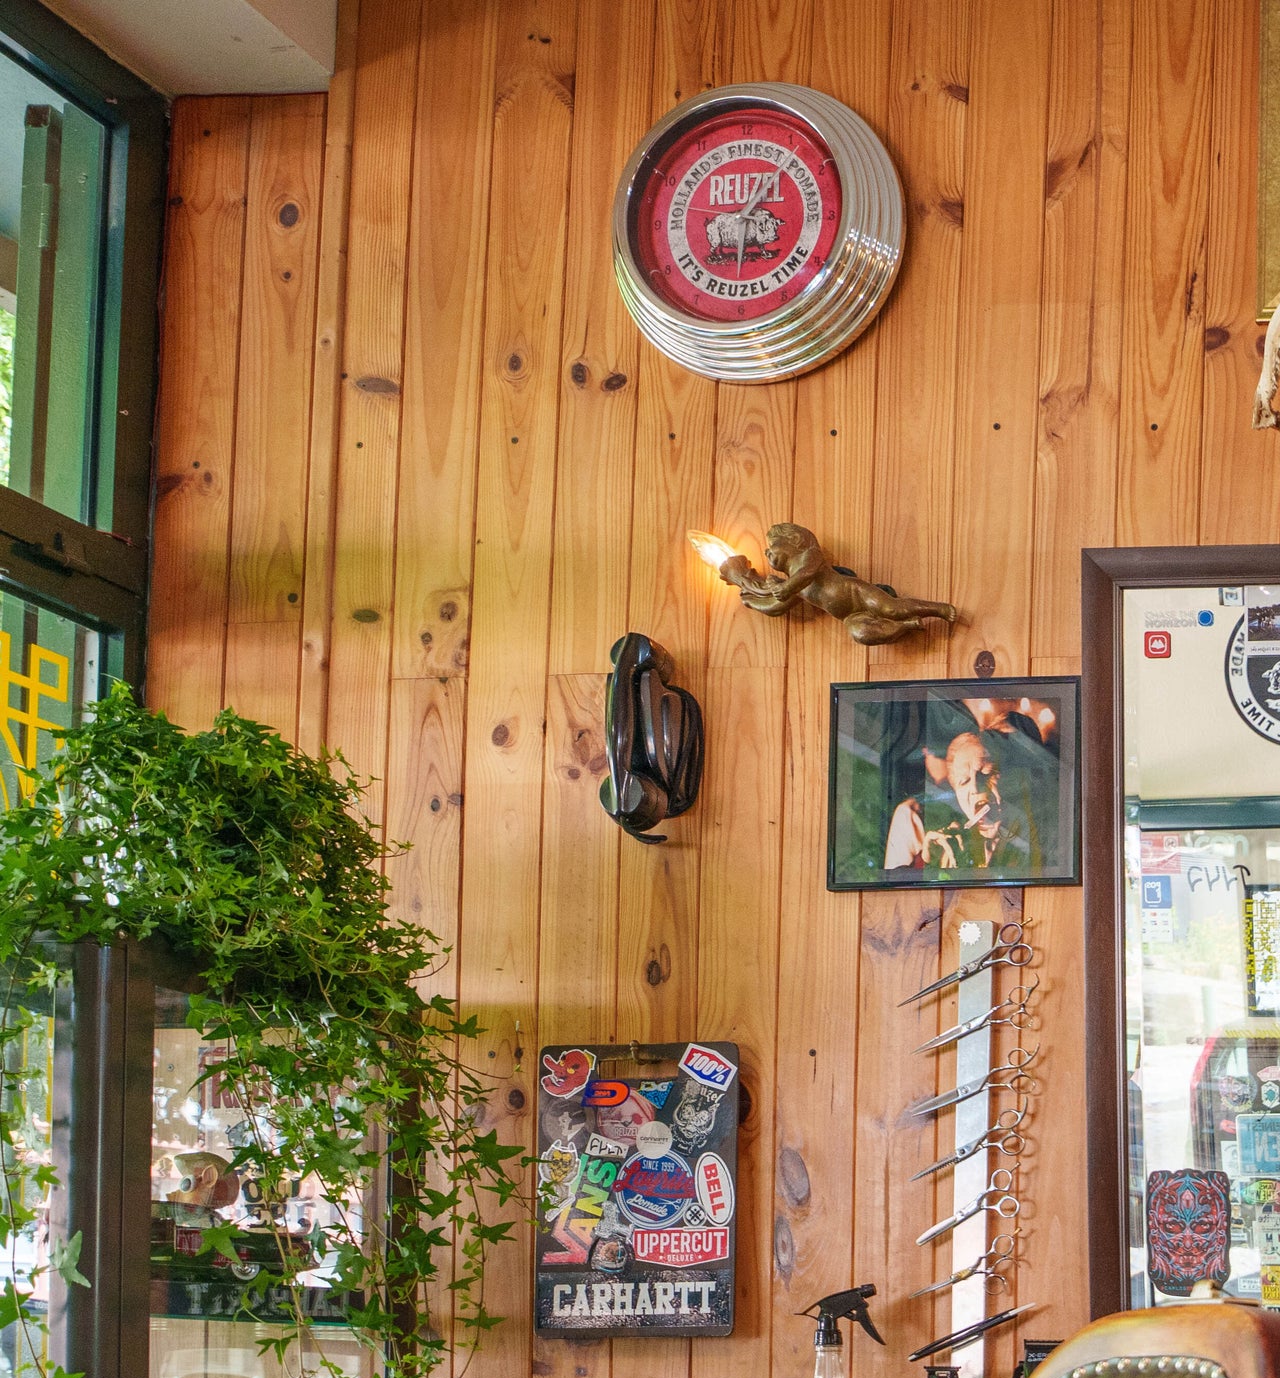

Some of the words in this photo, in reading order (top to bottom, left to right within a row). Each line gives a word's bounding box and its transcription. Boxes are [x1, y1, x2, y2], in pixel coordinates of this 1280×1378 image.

[741, 125, 753, 136] 12
[788, 134, 793, 145] 1
[696, 141, 707, 151] 11
[818, 164, 825, 176] 2
[664, 176, 676, 187] 10
[670, 152, 723, 231] HOLLAND'S
[727, 143, 785, 163] FINEST
[786, 157, 820, 223] POMADE
[709, 172, 785, 206] REUZEL
[828, 210, 835, 221] 3
[654, 220, 662, 230] 9
[813, 256, 821, 266] 4
[665, 264, 672, 275] 8
[677, 252, 703, 282] IT'S
[706, 277, 770, 298] REUZEL
[771, 246, 810, 285] TIME
[693, 294, 700, 305] 7
[737, 305, 745, 315] 6
[688, 1051, 730, 1083] 100%
[641, 1159, 660, 1171] SINCE
[661, 1161, 676, 1173] 1999
[703, 1162, 726, 1217] BELL
[627, 1193, 669, 1217] Pomade
[636, 1231, 725, 1258] UPPERCUT
[666, 1254, 694, 1262] DELUXE
[552, 1281, 716, 1318] CARHARTT
